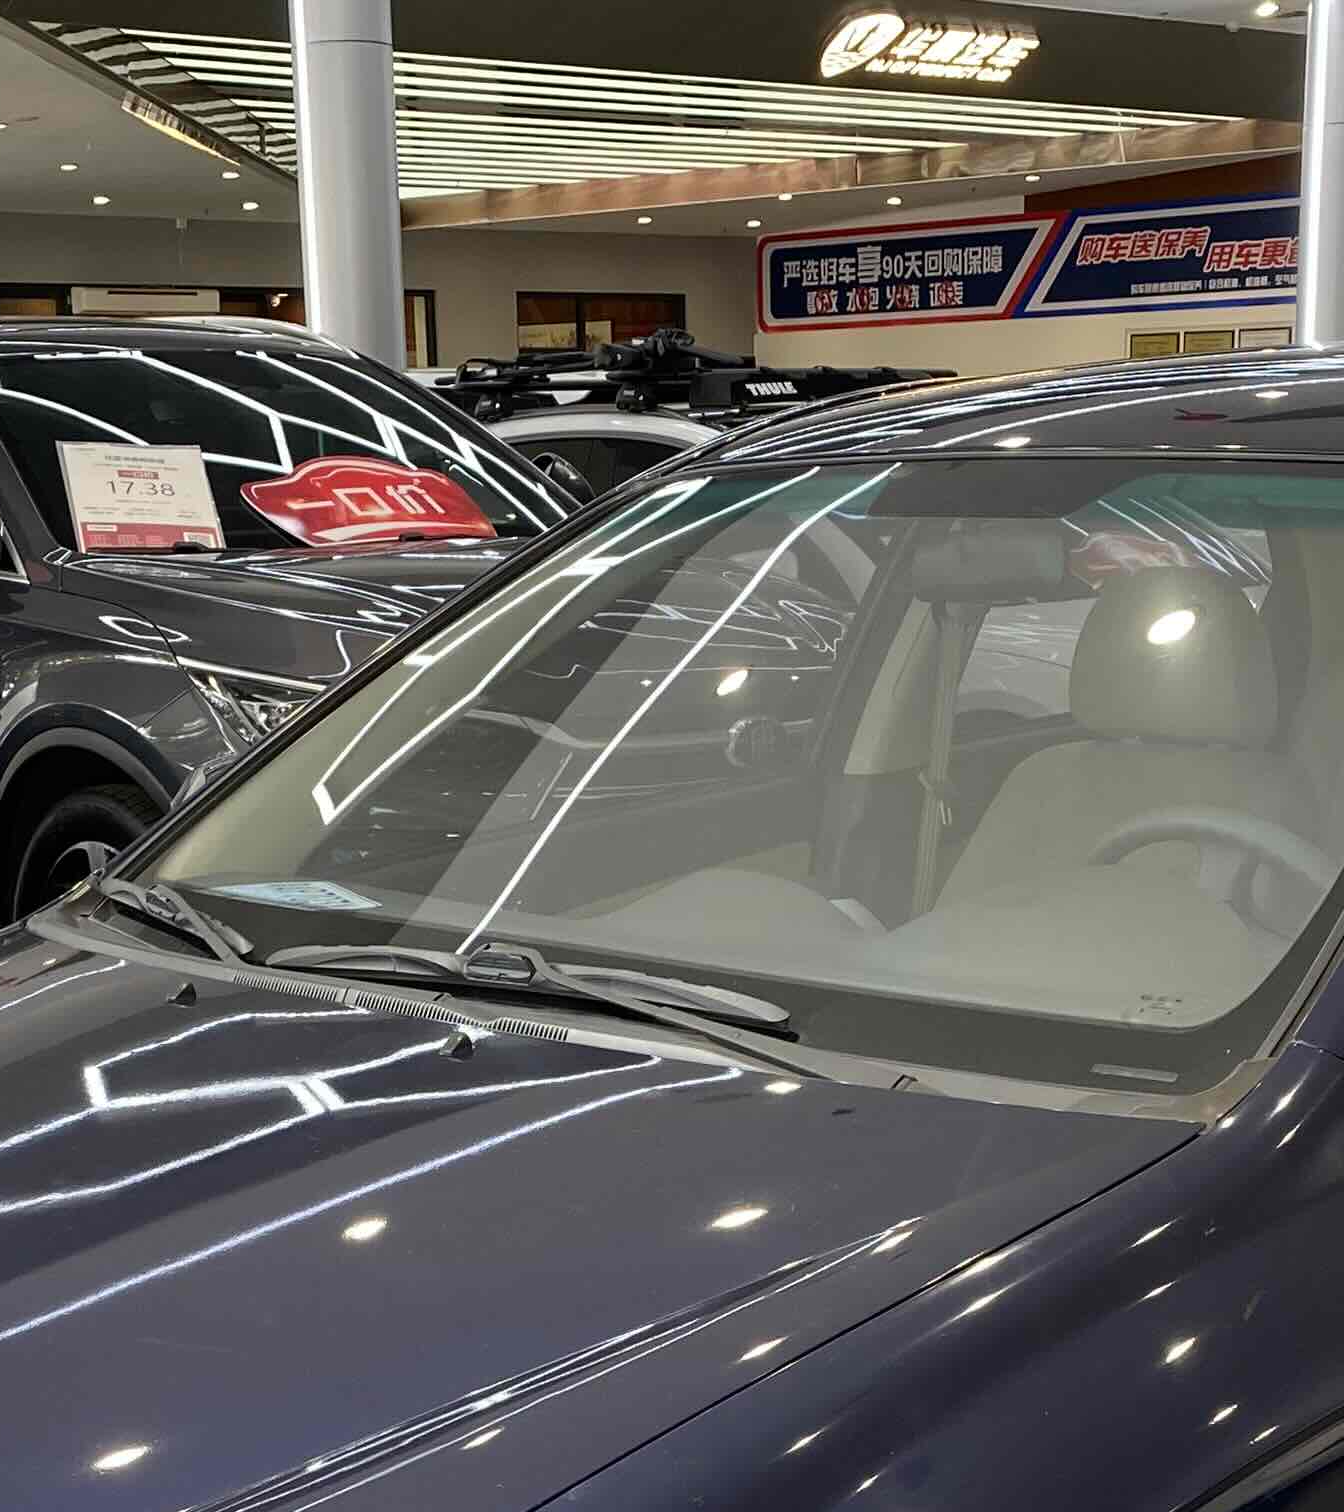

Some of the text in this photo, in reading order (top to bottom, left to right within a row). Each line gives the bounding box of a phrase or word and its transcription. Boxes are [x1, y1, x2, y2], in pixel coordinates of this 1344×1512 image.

[783, 244, 1004, 288] 严选好车享90天回购保障
[1076, 226, 1299, 272] 购车送保养 用车更
[745, 381, 798, 396] THULE
[106, 480, 176, 497] 17.38
[286, 479, 446, 517] 一口价
